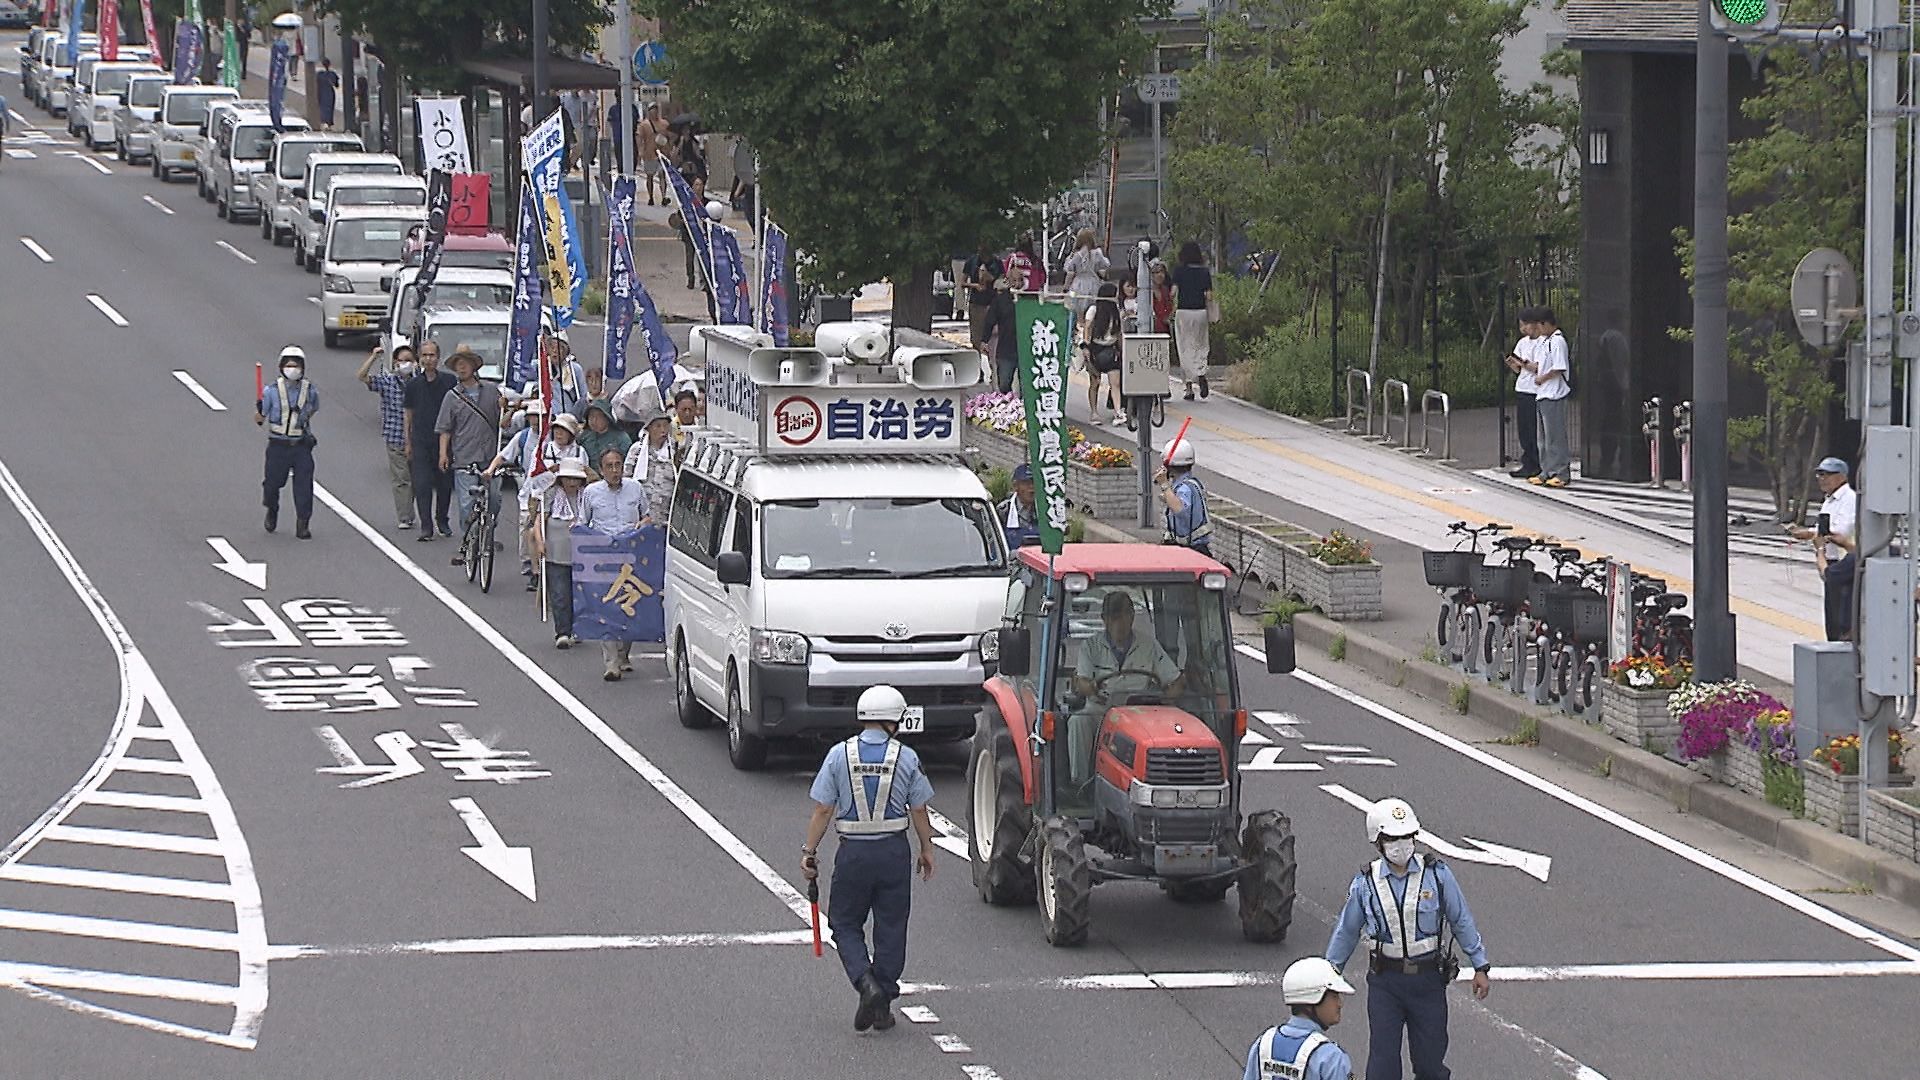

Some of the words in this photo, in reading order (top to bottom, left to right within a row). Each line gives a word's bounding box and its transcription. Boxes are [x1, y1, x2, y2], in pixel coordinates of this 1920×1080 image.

[827, 397, 955, 440] 自治労
[601, 563, 654, 617] 令
